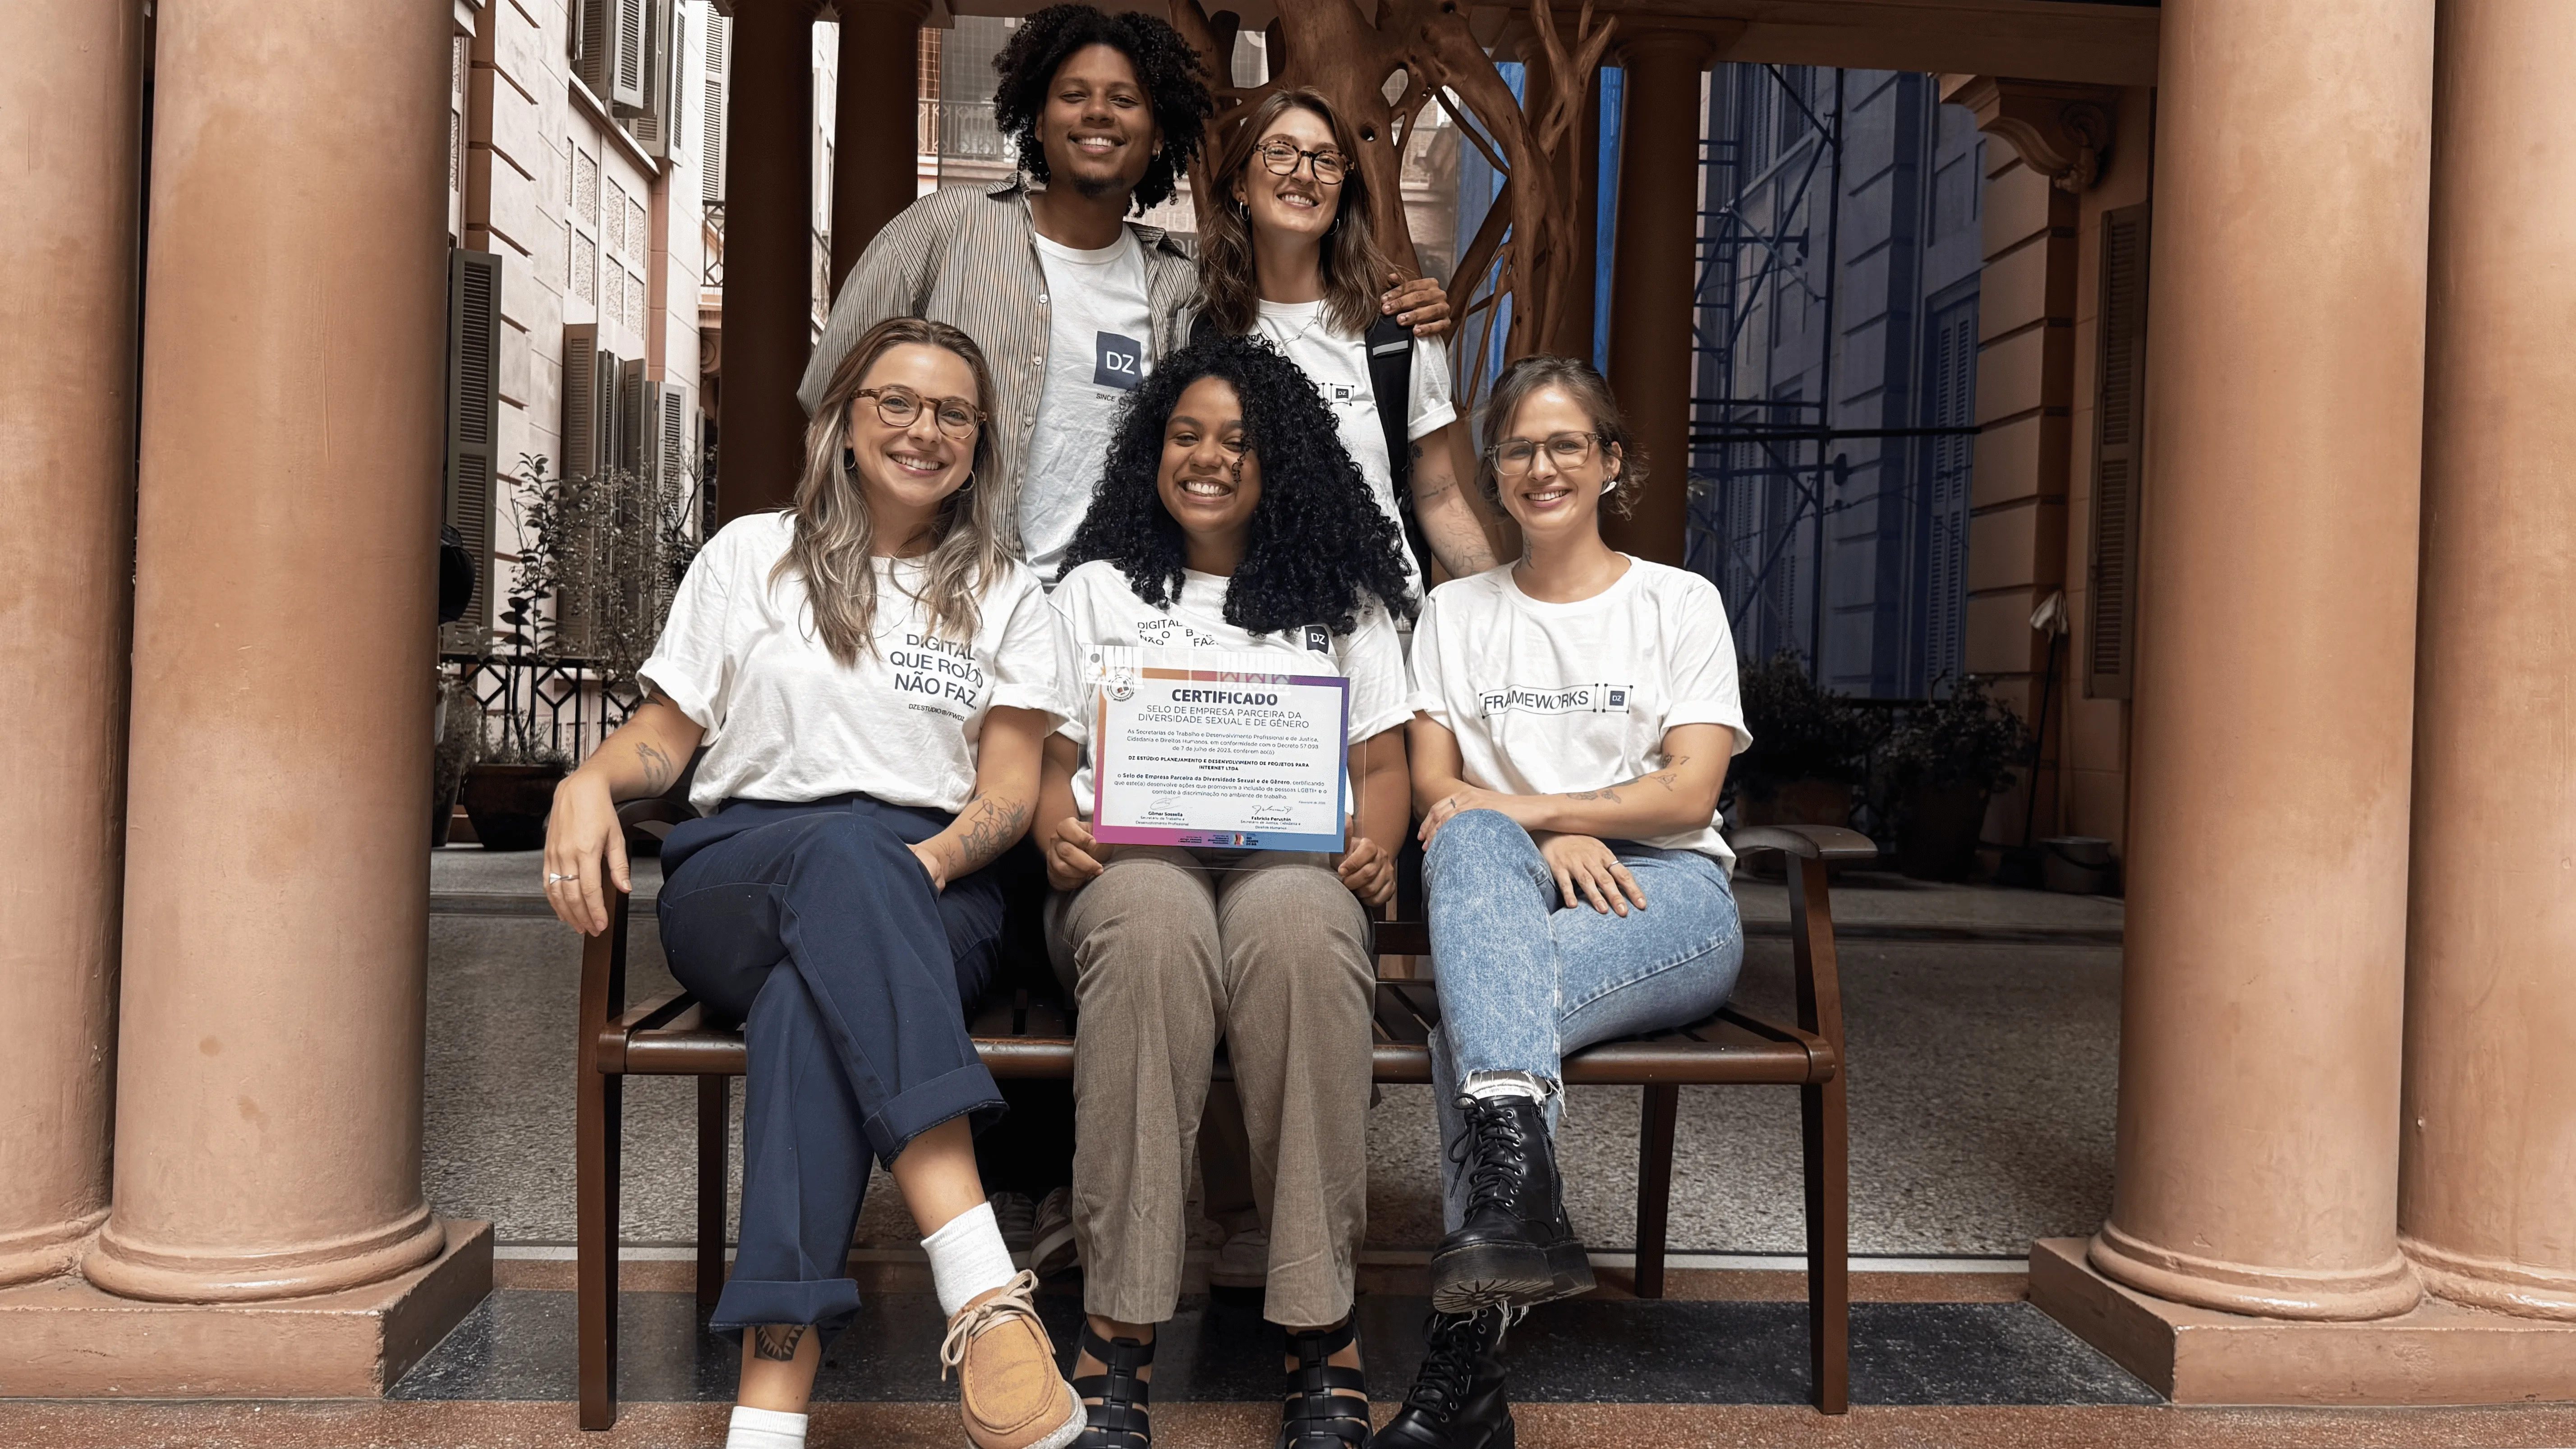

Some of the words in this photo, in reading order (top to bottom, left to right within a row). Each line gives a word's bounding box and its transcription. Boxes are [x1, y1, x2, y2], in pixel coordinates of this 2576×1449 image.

[1106, 350, 1135, 375] DZ
[1096, 393, 1116, 402] SINCE
[1137, 619, 1183, 630] DIGITAL
[906, 634, 976, 661] DIGITAL
[1311, 633, 1325, 645] DZ
[890, 651, 933, 670] QUE
[894, 671, 940, 695] NÃO
[945, 681, 977, 710] FAZ.
[1172, 689, 1278, 706] CERTIFICADO
[1484, 690, 1589, 710] FRAMEWORKS
[1147, 705, 1171, 713] SELO
[1190, 707, 1234, 716] EMPRESA
[1237, 709, 1285, 718] PARCEIRA
[1139, 713, 1202, 723] DIVERSIDADE
[1205, 717, 1242, 725] SEXUAL
[1270, 719, 1309, 728] GÊNERO
